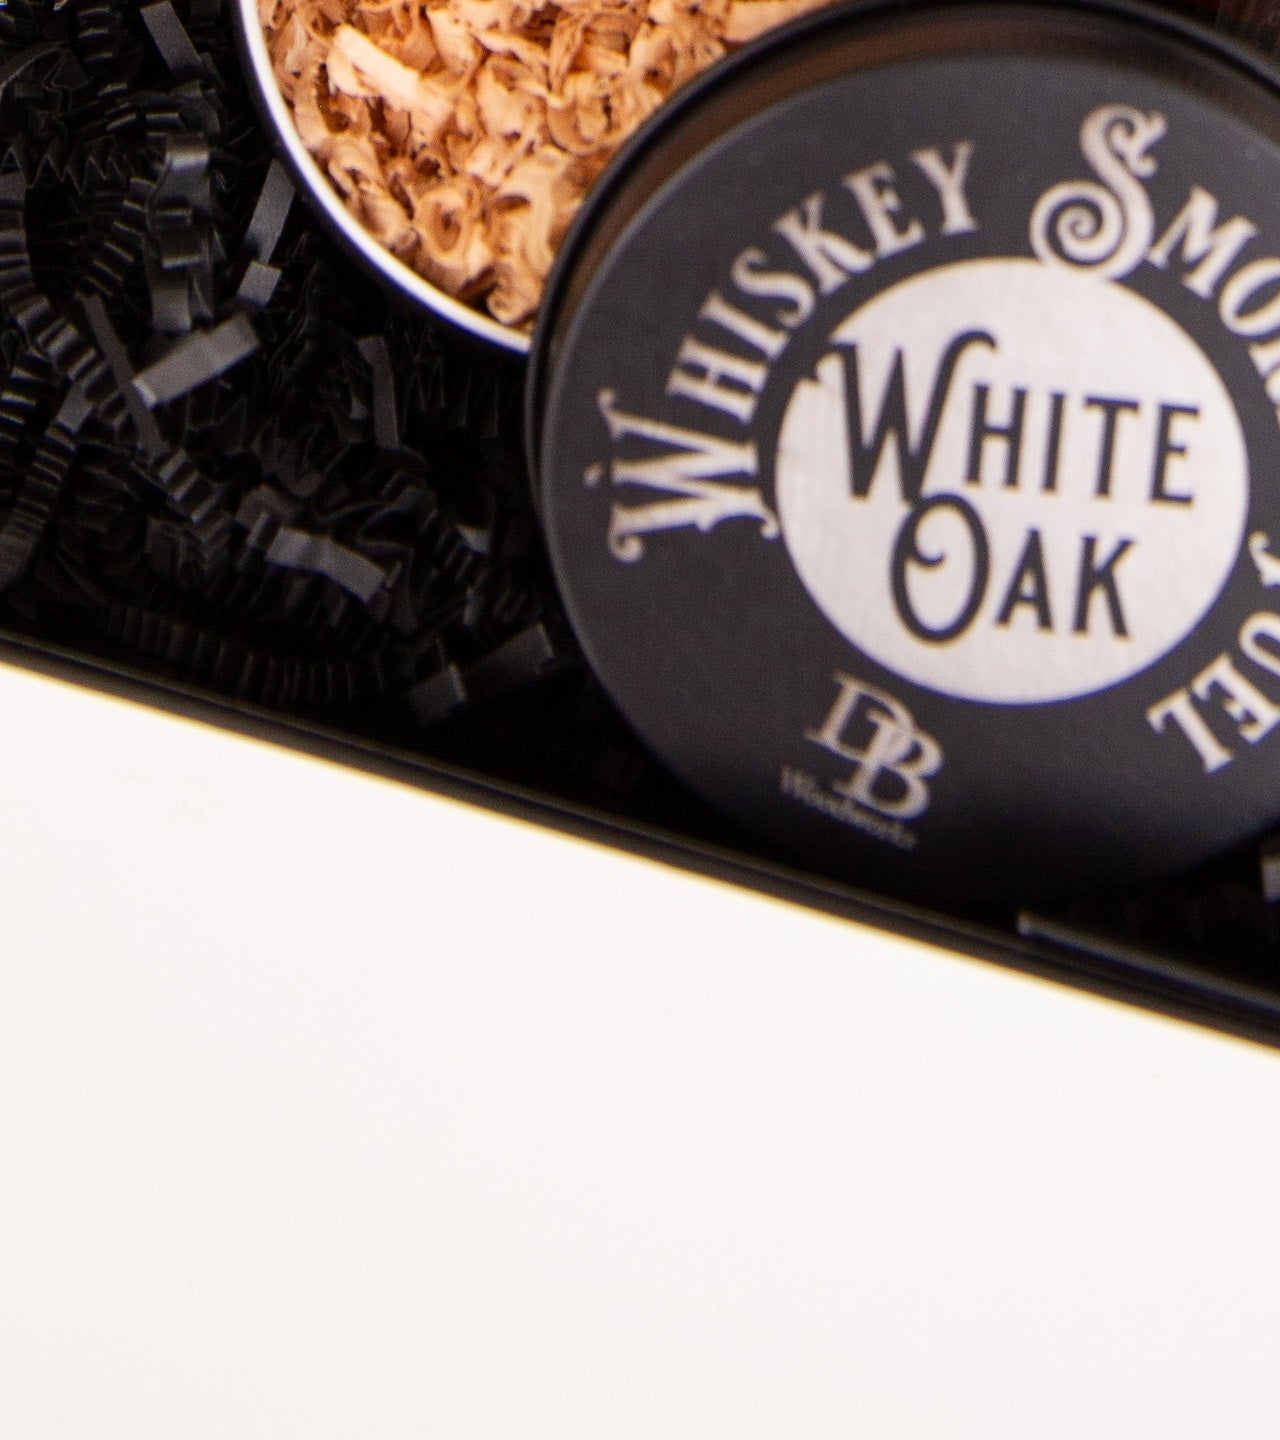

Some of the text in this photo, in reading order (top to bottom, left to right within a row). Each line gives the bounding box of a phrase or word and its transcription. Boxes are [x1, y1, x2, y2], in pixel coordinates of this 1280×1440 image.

[584, 141, 978, 563] WHISKEY
[816, 329, 1203, 507] WHITE
[891, 494, 1141, 646] OAK
